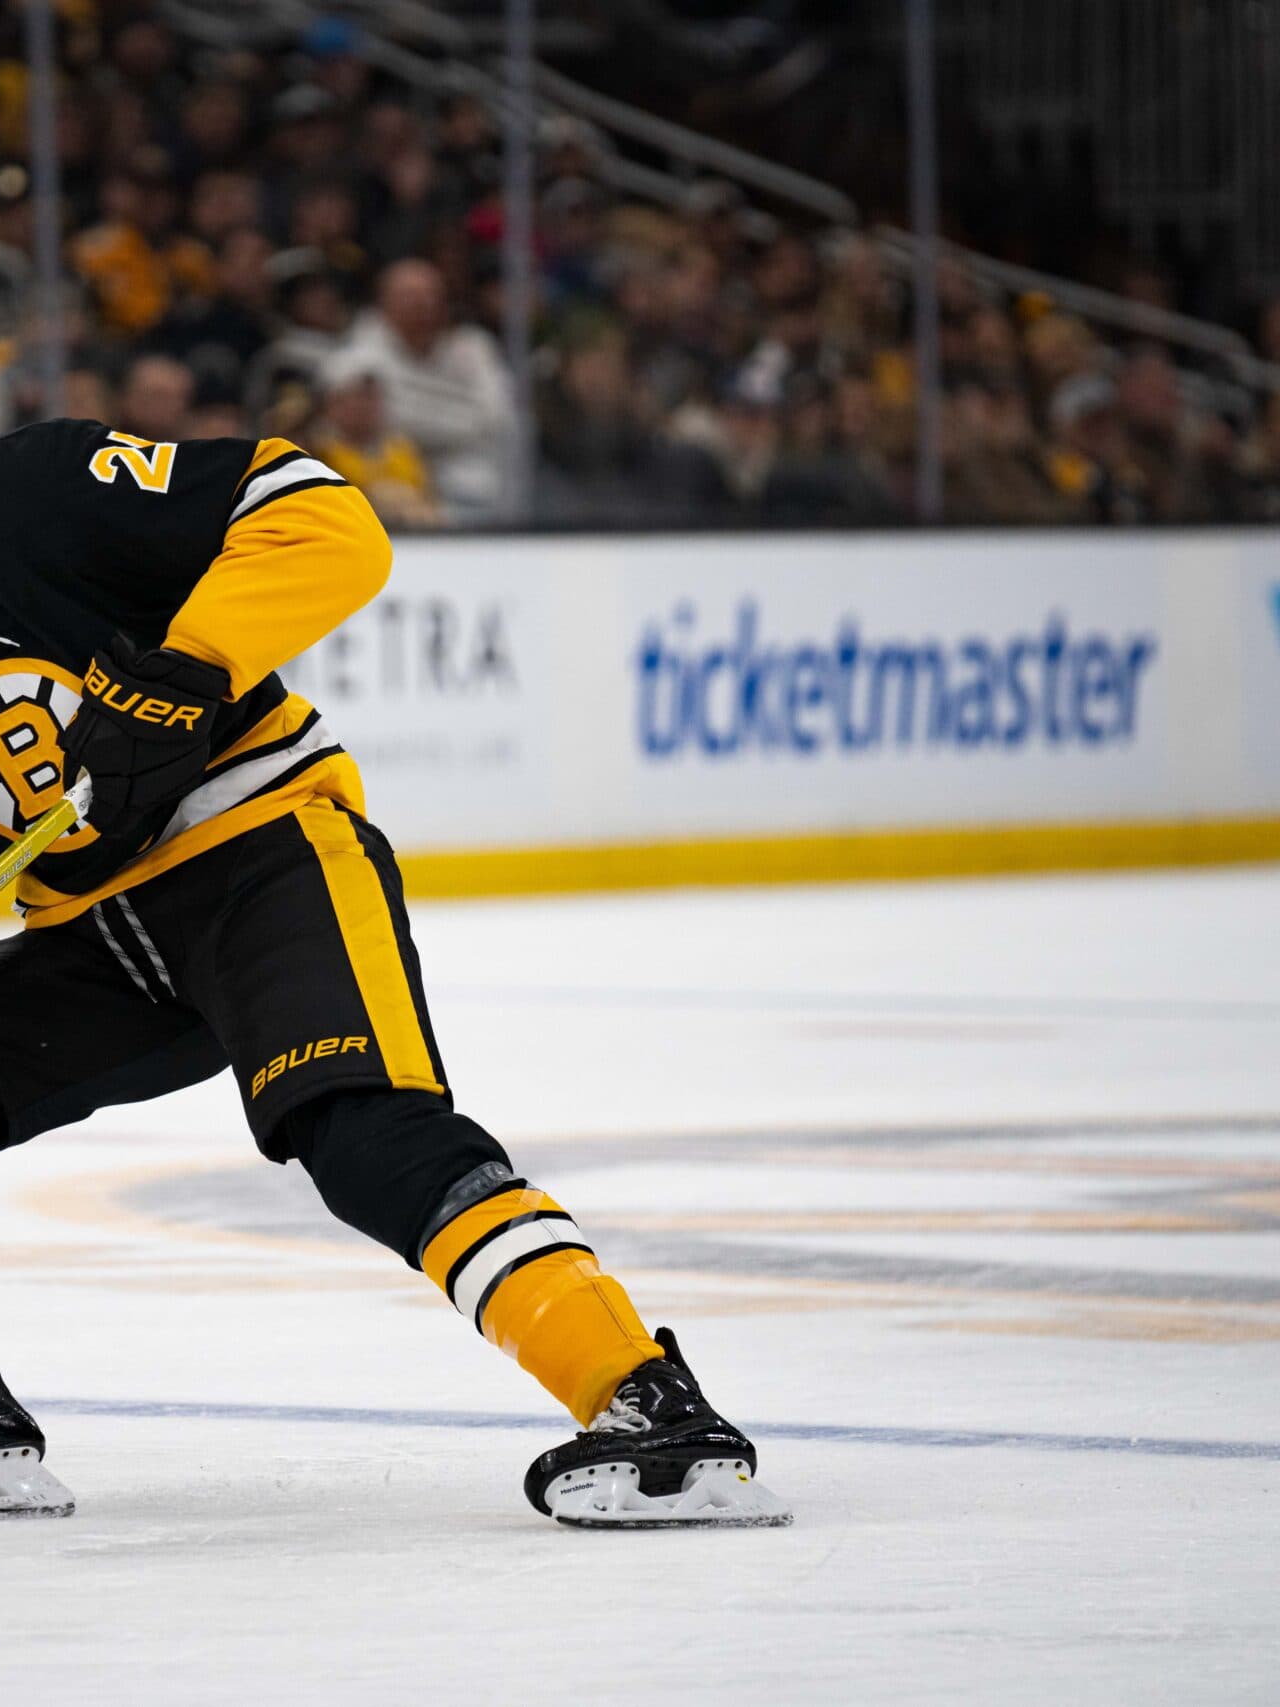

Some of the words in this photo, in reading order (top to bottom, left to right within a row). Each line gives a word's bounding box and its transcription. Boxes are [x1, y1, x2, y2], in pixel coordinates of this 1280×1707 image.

[88, 430, 178, 494] 2
[637, 597, 1160, 760] ticketmaster
[251, 1035, 369, 1100] BAUER
